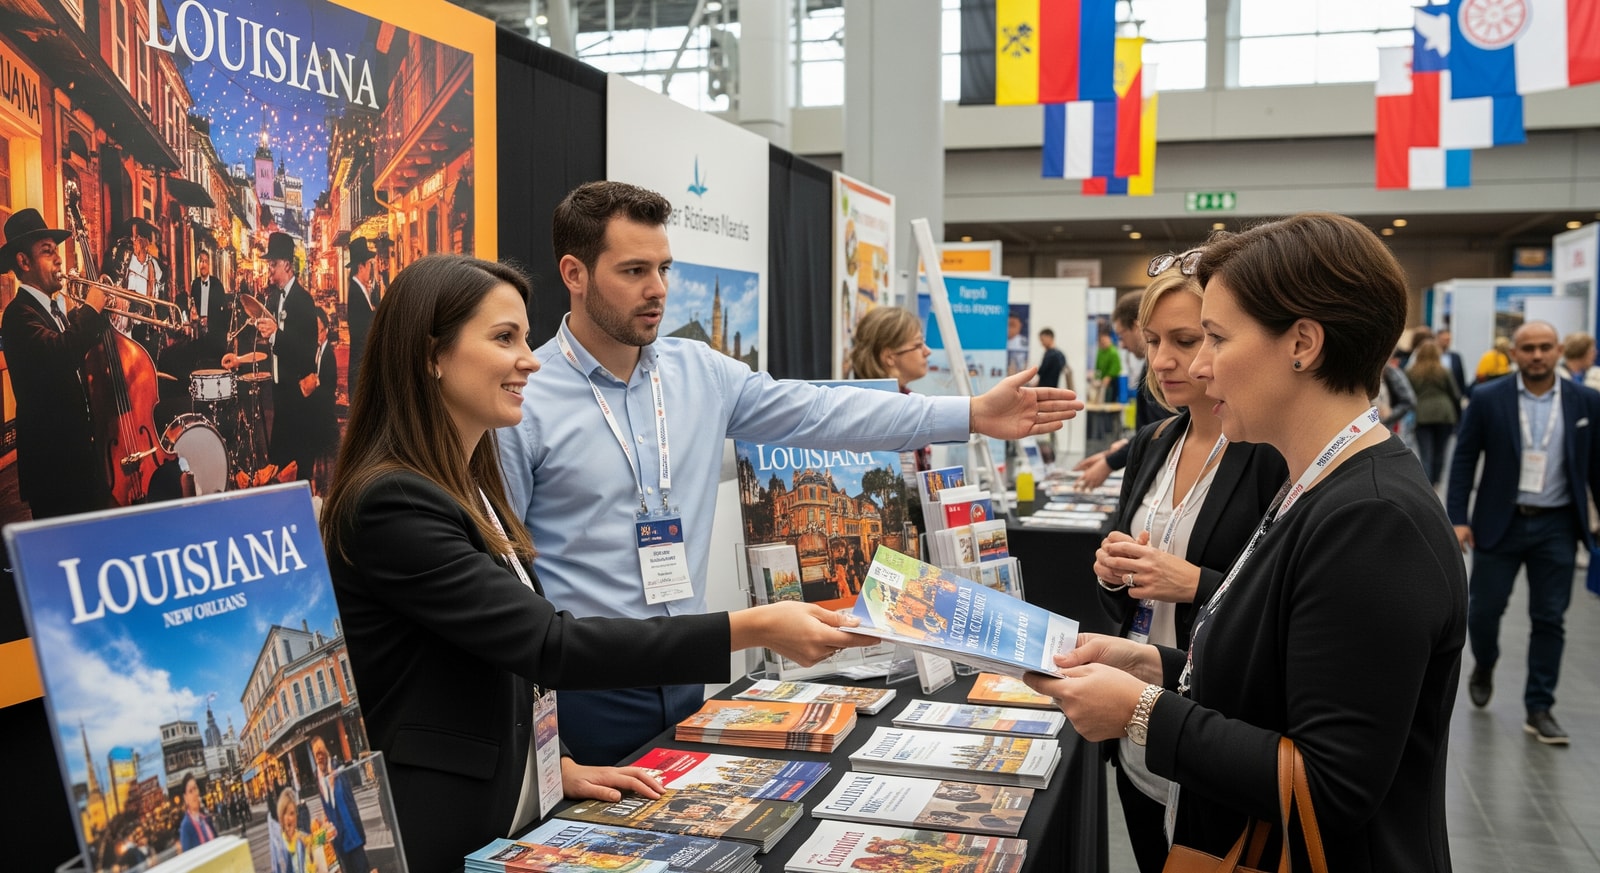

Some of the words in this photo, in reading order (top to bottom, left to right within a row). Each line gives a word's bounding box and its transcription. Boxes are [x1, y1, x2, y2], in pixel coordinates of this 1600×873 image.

[145, 0, 380, 110] LOUISIANA
[756, 444, 876, 471] LOUISIANA
[163, 606, 194, 628] NEW
[195, 592, 248, 620] ORLEANS
